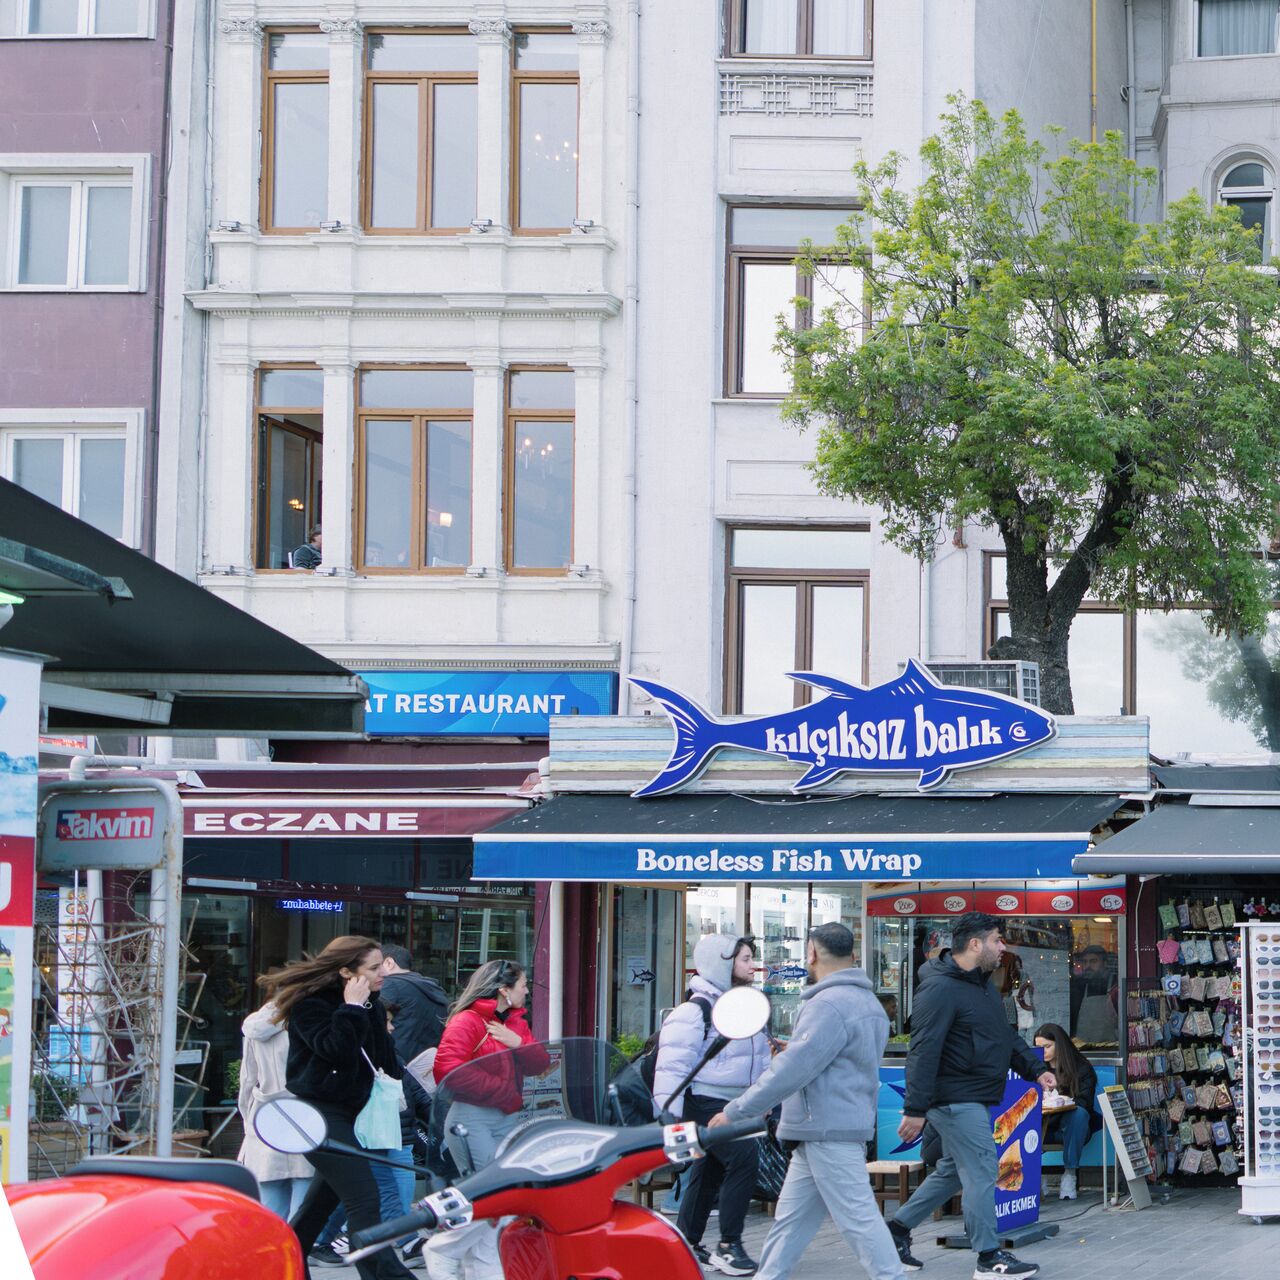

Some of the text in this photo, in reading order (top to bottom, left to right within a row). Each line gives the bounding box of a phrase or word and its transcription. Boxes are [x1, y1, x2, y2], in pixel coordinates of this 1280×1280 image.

[395, 694, 566, 714] RESTAURANT
[765, 704, 1003, 767] kılçıksız balık
[61, 810, 151, 839] Takvim
[194, 812, 419, 832] ECZANE
[636, 847, 922, 878] Boneless Fish Wrap
[995, 1194, 1038, 1218] ALIK EKMEK
